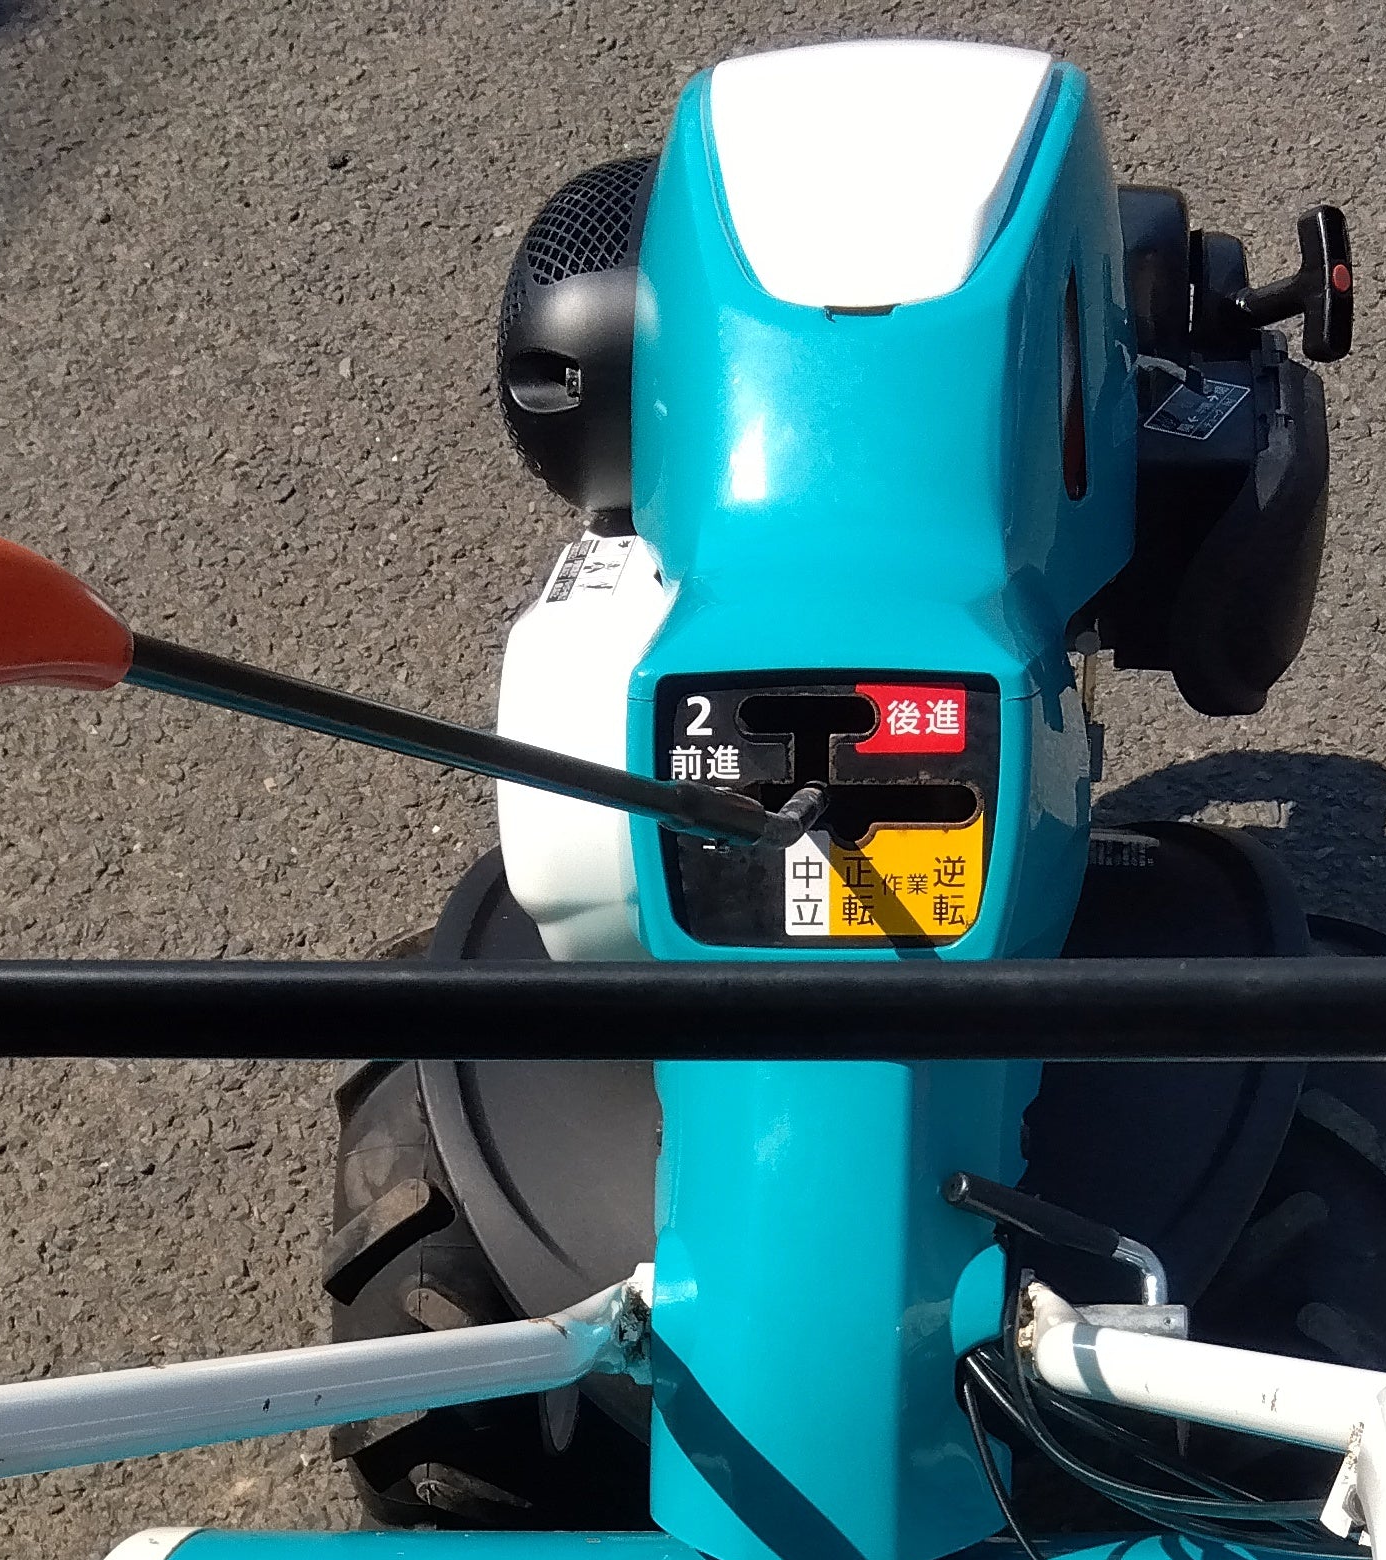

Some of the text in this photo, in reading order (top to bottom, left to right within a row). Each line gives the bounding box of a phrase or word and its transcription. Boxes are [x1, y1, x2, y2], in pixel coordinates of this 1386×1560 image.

[686, 696, 712, 736] 2
[887, 700, 960, 735] 後進
[671, 745, 740, 780] 前進
[792, 856, 823, 926] 中立
[842, 856, 874, 926] 正転
[881, 873, 928, 895] 作業
[933, 856, 966, 926] 逆転
